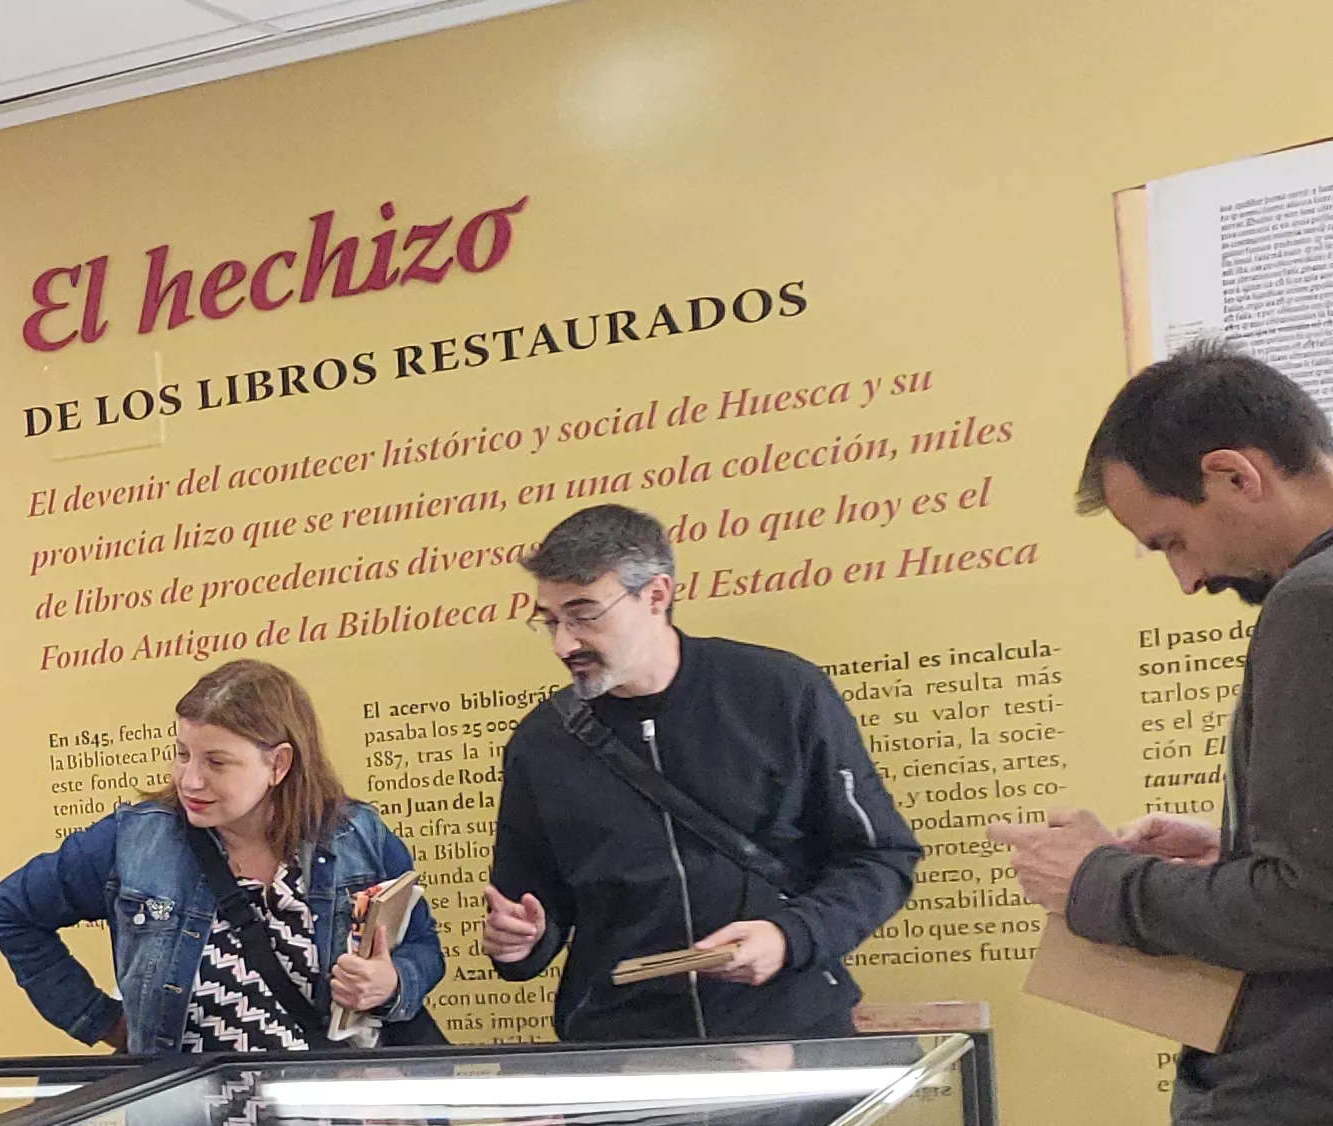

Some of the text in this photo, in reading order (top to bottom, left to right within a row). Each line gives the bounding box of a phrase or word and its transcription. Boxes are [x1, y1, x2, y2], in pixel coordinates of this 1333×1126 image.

[22, 194, 530, 352] El hechizo
[23, 280, 809, 438] DE LOS LIBROS RESTAURADOS
[27, 368, 935, 518] El devenir del acontecer histórico y social de Huesca y su
[30, 415, 1015, 577] provincia hizo que se reunieran, en una sola colección, miles
[718, 475, 994, 542] lo que hoy es el
[708, 540, 1040, 599] Estado en Huesca
[35, 554, 399, 620] de libros de procedencias
[39, 597, 498, 671] Fondo Antiguo de la Biblioteca
[1139, 628, 1223, 650] El paso
[918, 653, 941, 668] es
[949, 640, 1062, 666] incalcula-
[1139, 661, 1181, 676] son
[841, 666, 1062, 702] odavía resulta más
[1141, 682, 1210, 705] tarlos
[363, 700, 450, 719] El acervo
[894, 710, 919, 724] su
[932, 699, 990, 721] valor
[1004, 693, 1063, 715] testi-
[1141, 716, 1165, 732] es
[1173, 709, 1192, 730] el
[49, 723, 163, 748] En 1845, fecha
[365, 722, 427, 746] pasaba
[432, 720, 458, 738] los
[462, 722, 482, 737] 25
[869, 722, 1065, 753] historia, la socie-
[366, 742, 479, 770] 1887, tras la
[1143, 735, 1226, 760] ción El
[50, 751, 148, 771] la Biblioteca
[903, 752, 1068, 778] ciencias, artes,
[51, 772, 139, 793] este fondo
[368, 770, 454, 792] fondos de
[925, 779, 1067, 803] todos los co-
[53, 800, 105, 816] tenido
[406, 791, 495, 817] Juan de la
[420, 818, 461, 838] cifra
[431, 898, 449, 909] se
[904, 918, 1041, 941] lo que se nos
[475, 992, 511, 1005] uno
[515, 986, 536, 1003] de
[447, 1013, 483, 1030] más
